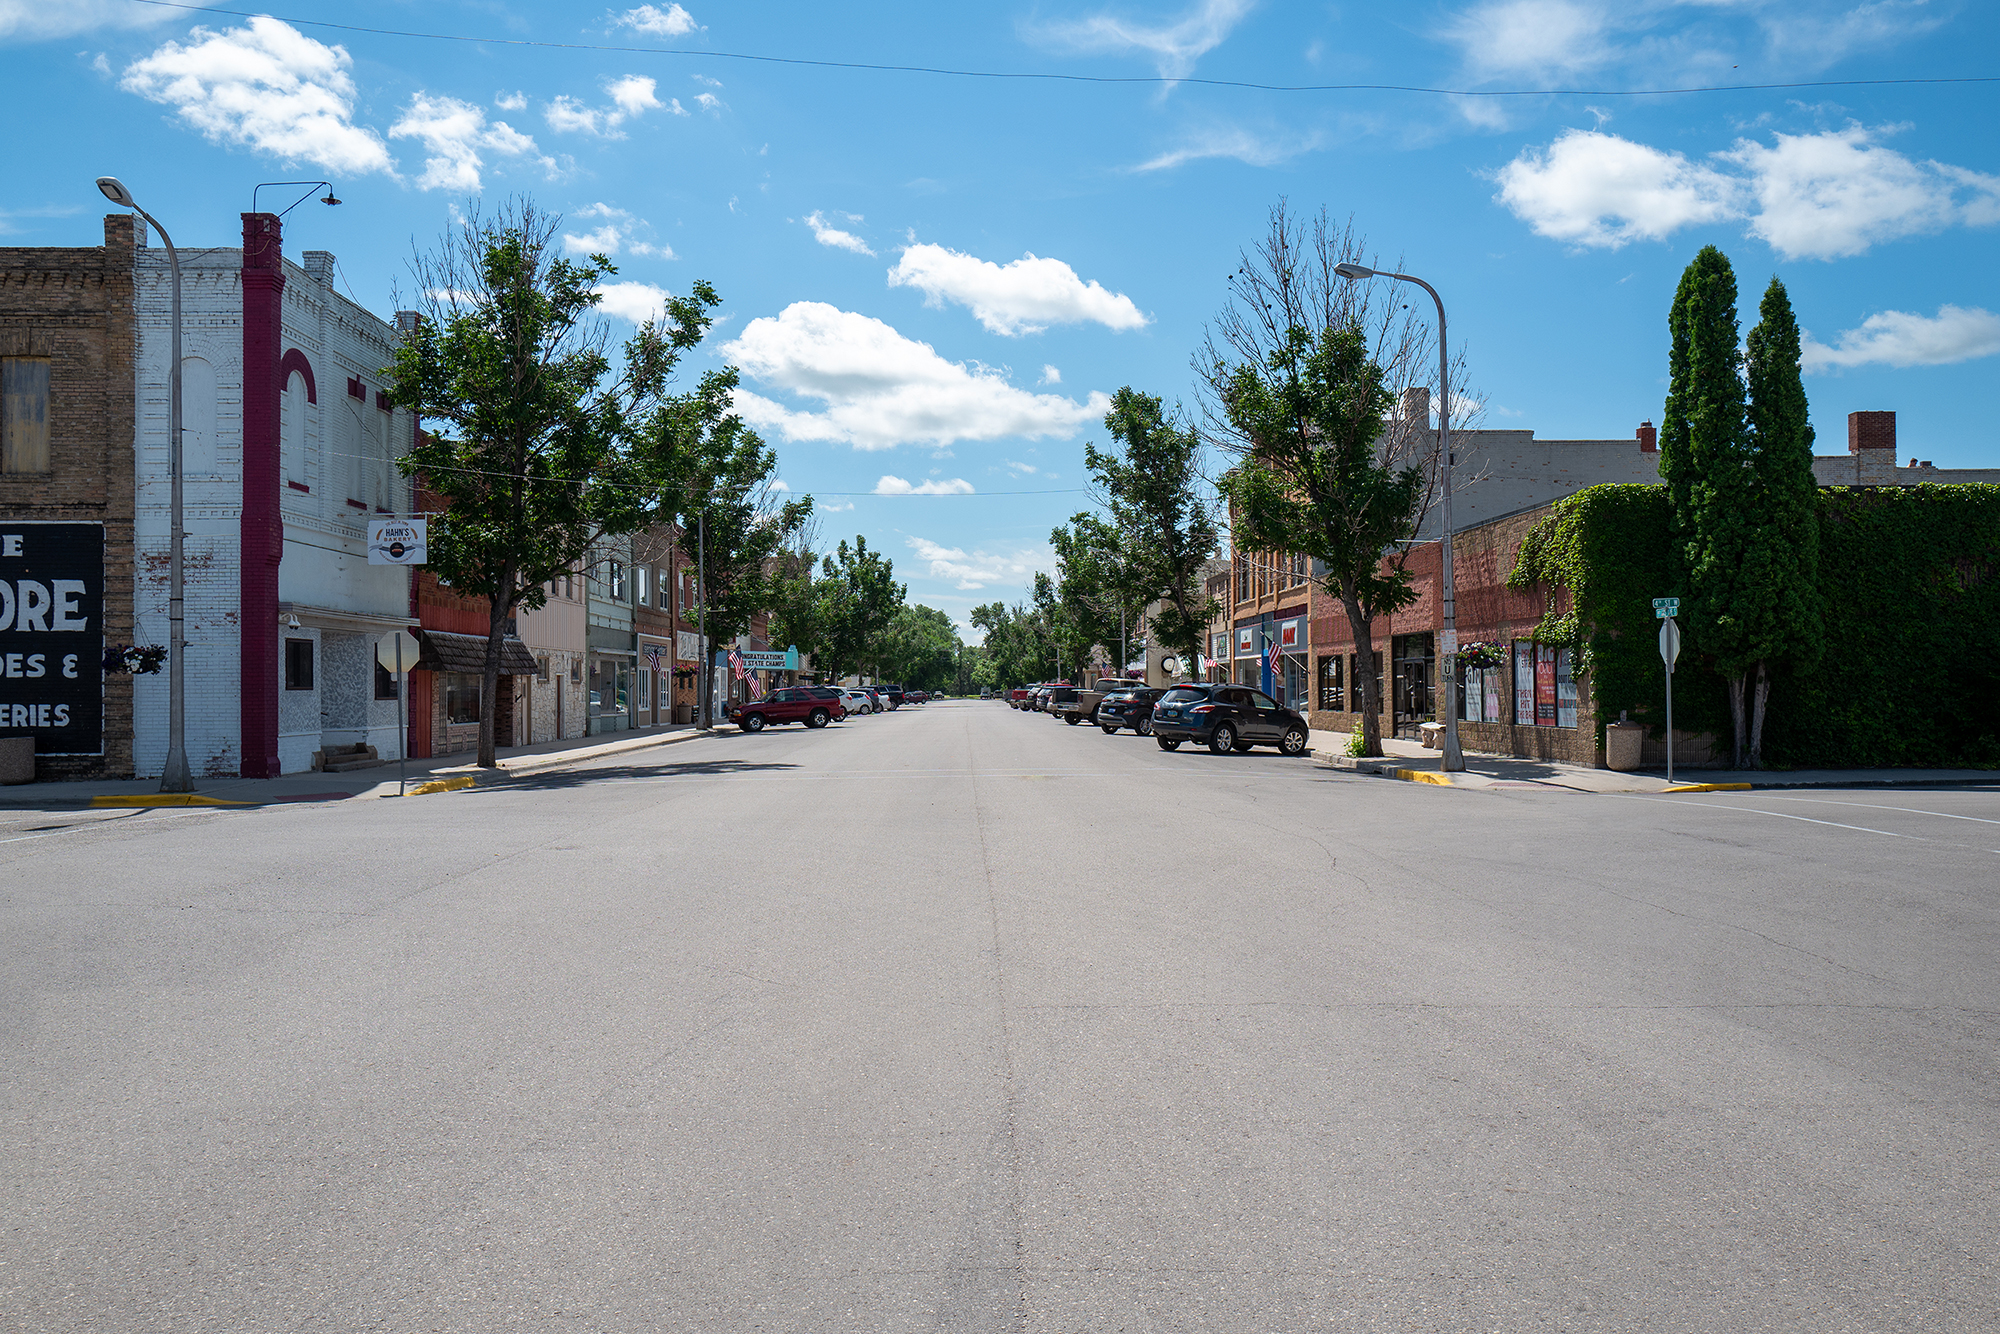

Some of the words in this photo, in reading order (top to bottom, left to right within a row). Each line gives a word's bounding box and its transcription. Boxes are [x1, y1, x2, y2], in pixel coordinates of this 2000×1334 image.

[386, 528, 409, 536] HAHN'S
[0, 654, 46, 678] ES
[62, 654, 78, 678] &
[1444, 666, 1450, 674] U
